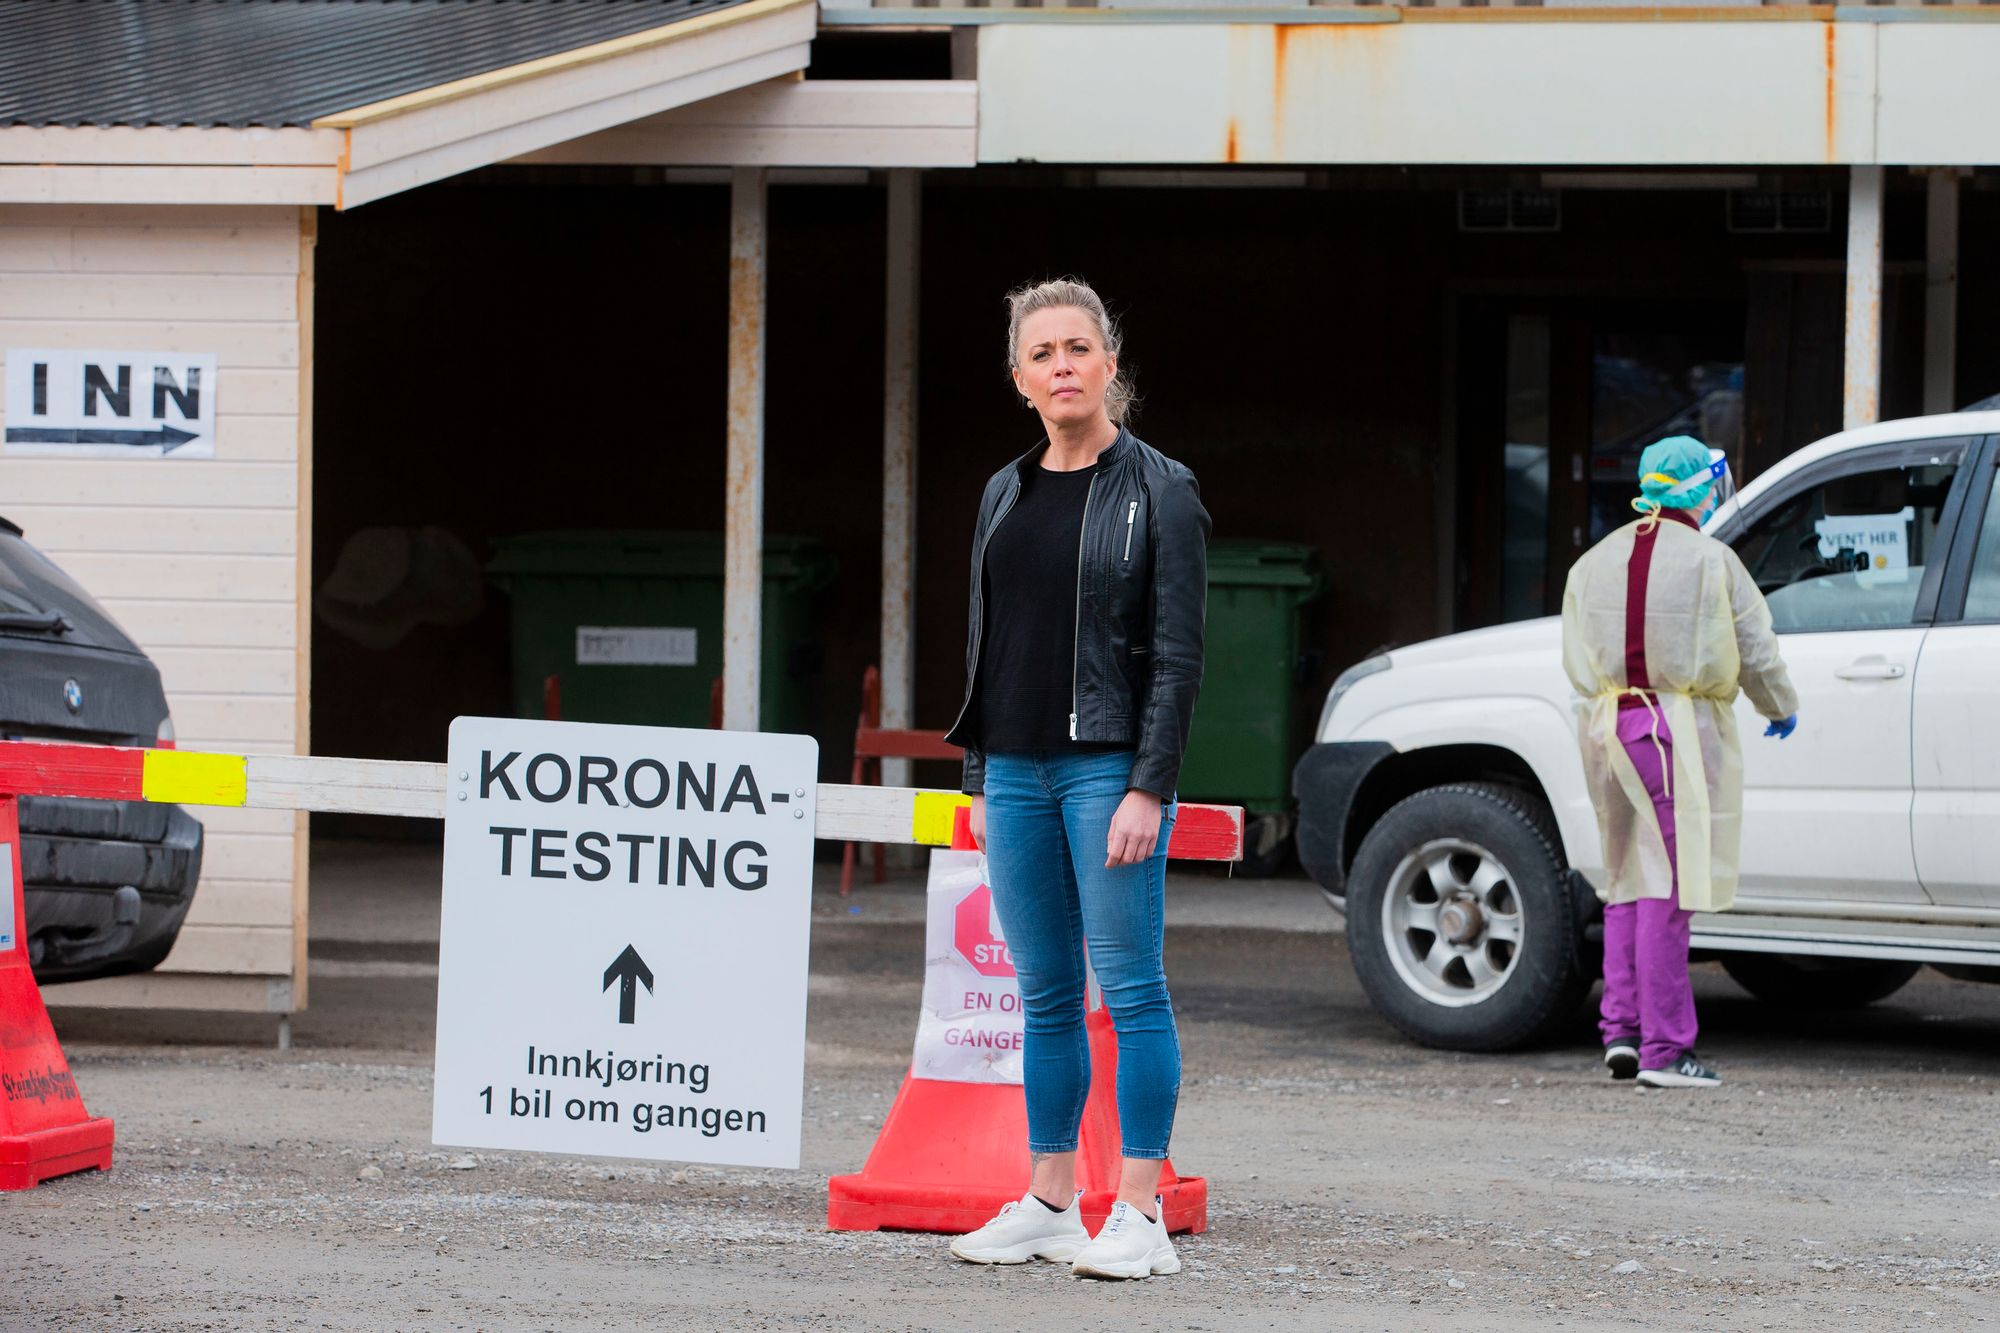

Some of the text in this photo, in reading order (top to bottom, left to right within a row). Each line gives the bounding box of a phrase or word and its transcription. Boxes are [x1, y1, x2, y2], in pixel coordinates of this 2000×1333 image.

[33, 362, 201, 420] INN
[1826, 530, 1898, 546] VENT HER
[480, 750, 790, 815] KORONA-
[490, 826, 768, 891] TESTING
[974, 944, 1014, 965] STO
[964, 991, 1023, 1012] EN O
[944, 1028, 1024, 1051] GANGE
[528, 1046, 710, 1094] Innkjøring
[479, 1086, 766, 1137] 1 bil om gangen
